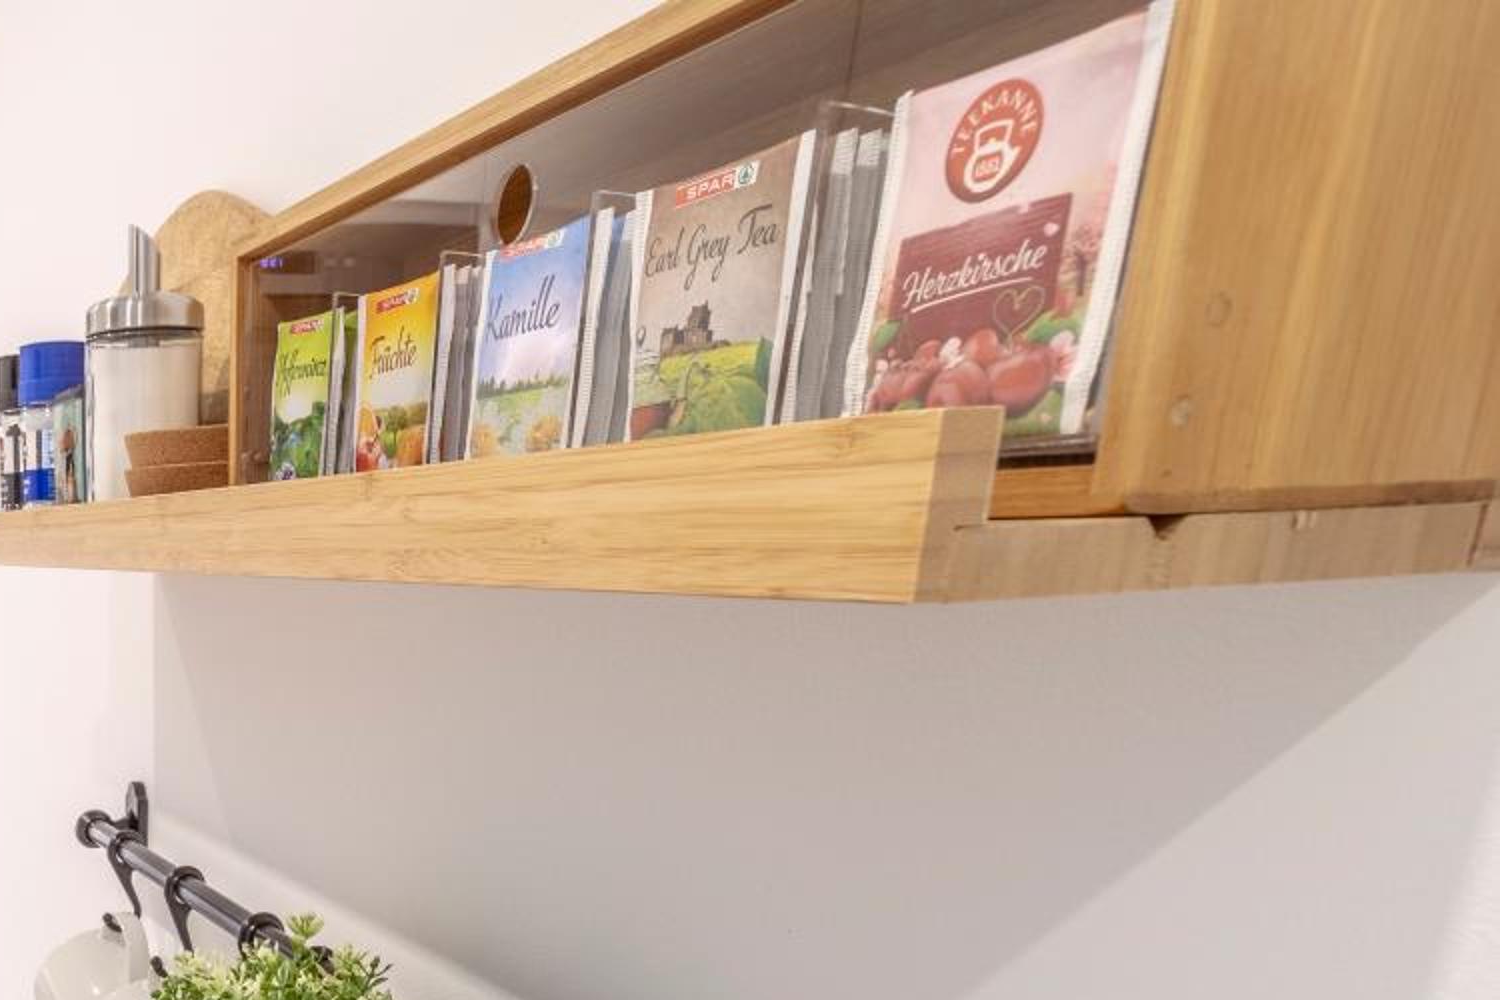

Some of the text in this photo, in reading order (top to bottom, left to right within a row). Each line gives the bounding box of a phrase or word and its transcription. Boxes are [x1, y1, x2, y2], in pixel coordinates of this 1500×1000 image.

[951, 87, 1038, 155] TEEKANNE
[686, 171, 735, 200] SPAR
[644, 203, 778, 291] Earl Grey Tea
[901, 238, 1048, 308] Herzkirsche
[485, 274, 560, 341] Kamille
[369, 324, 417, 379] Früchte
